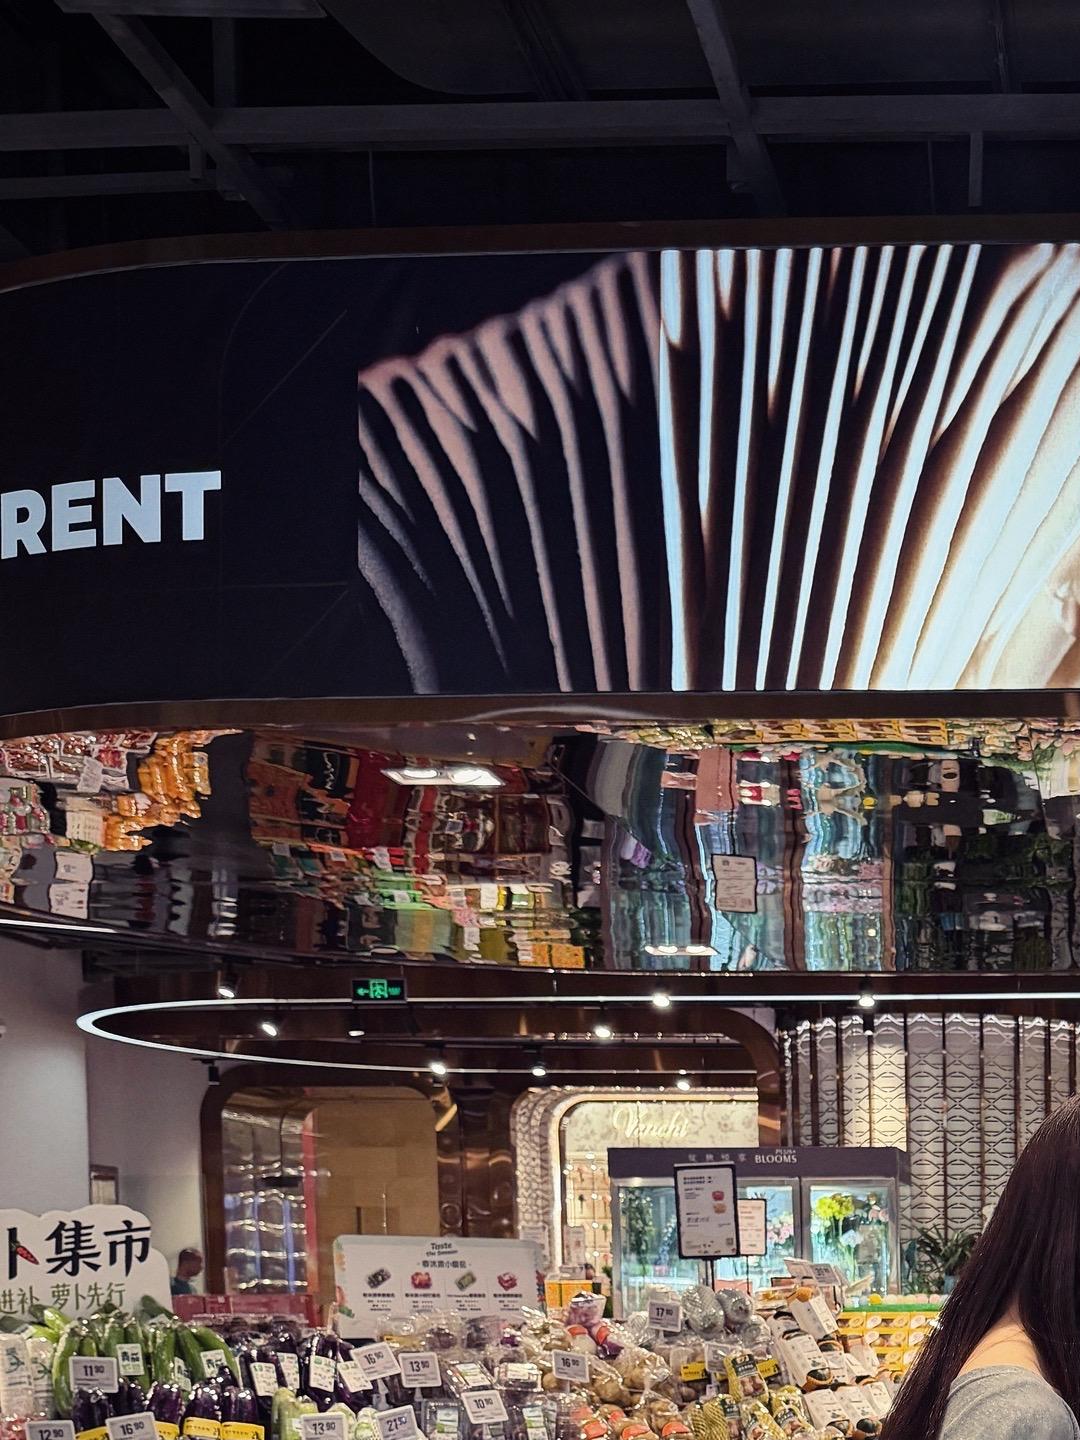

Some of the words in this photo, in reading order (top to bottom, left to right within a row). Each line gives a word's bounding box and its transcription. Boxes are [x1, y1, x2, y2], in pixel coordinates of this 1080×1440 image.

[0, 470, 221, 559] RENT
[754, 1154, 797, 1164] BLOOMS
[50, 1282, 126, 1311] 萝卜先行
